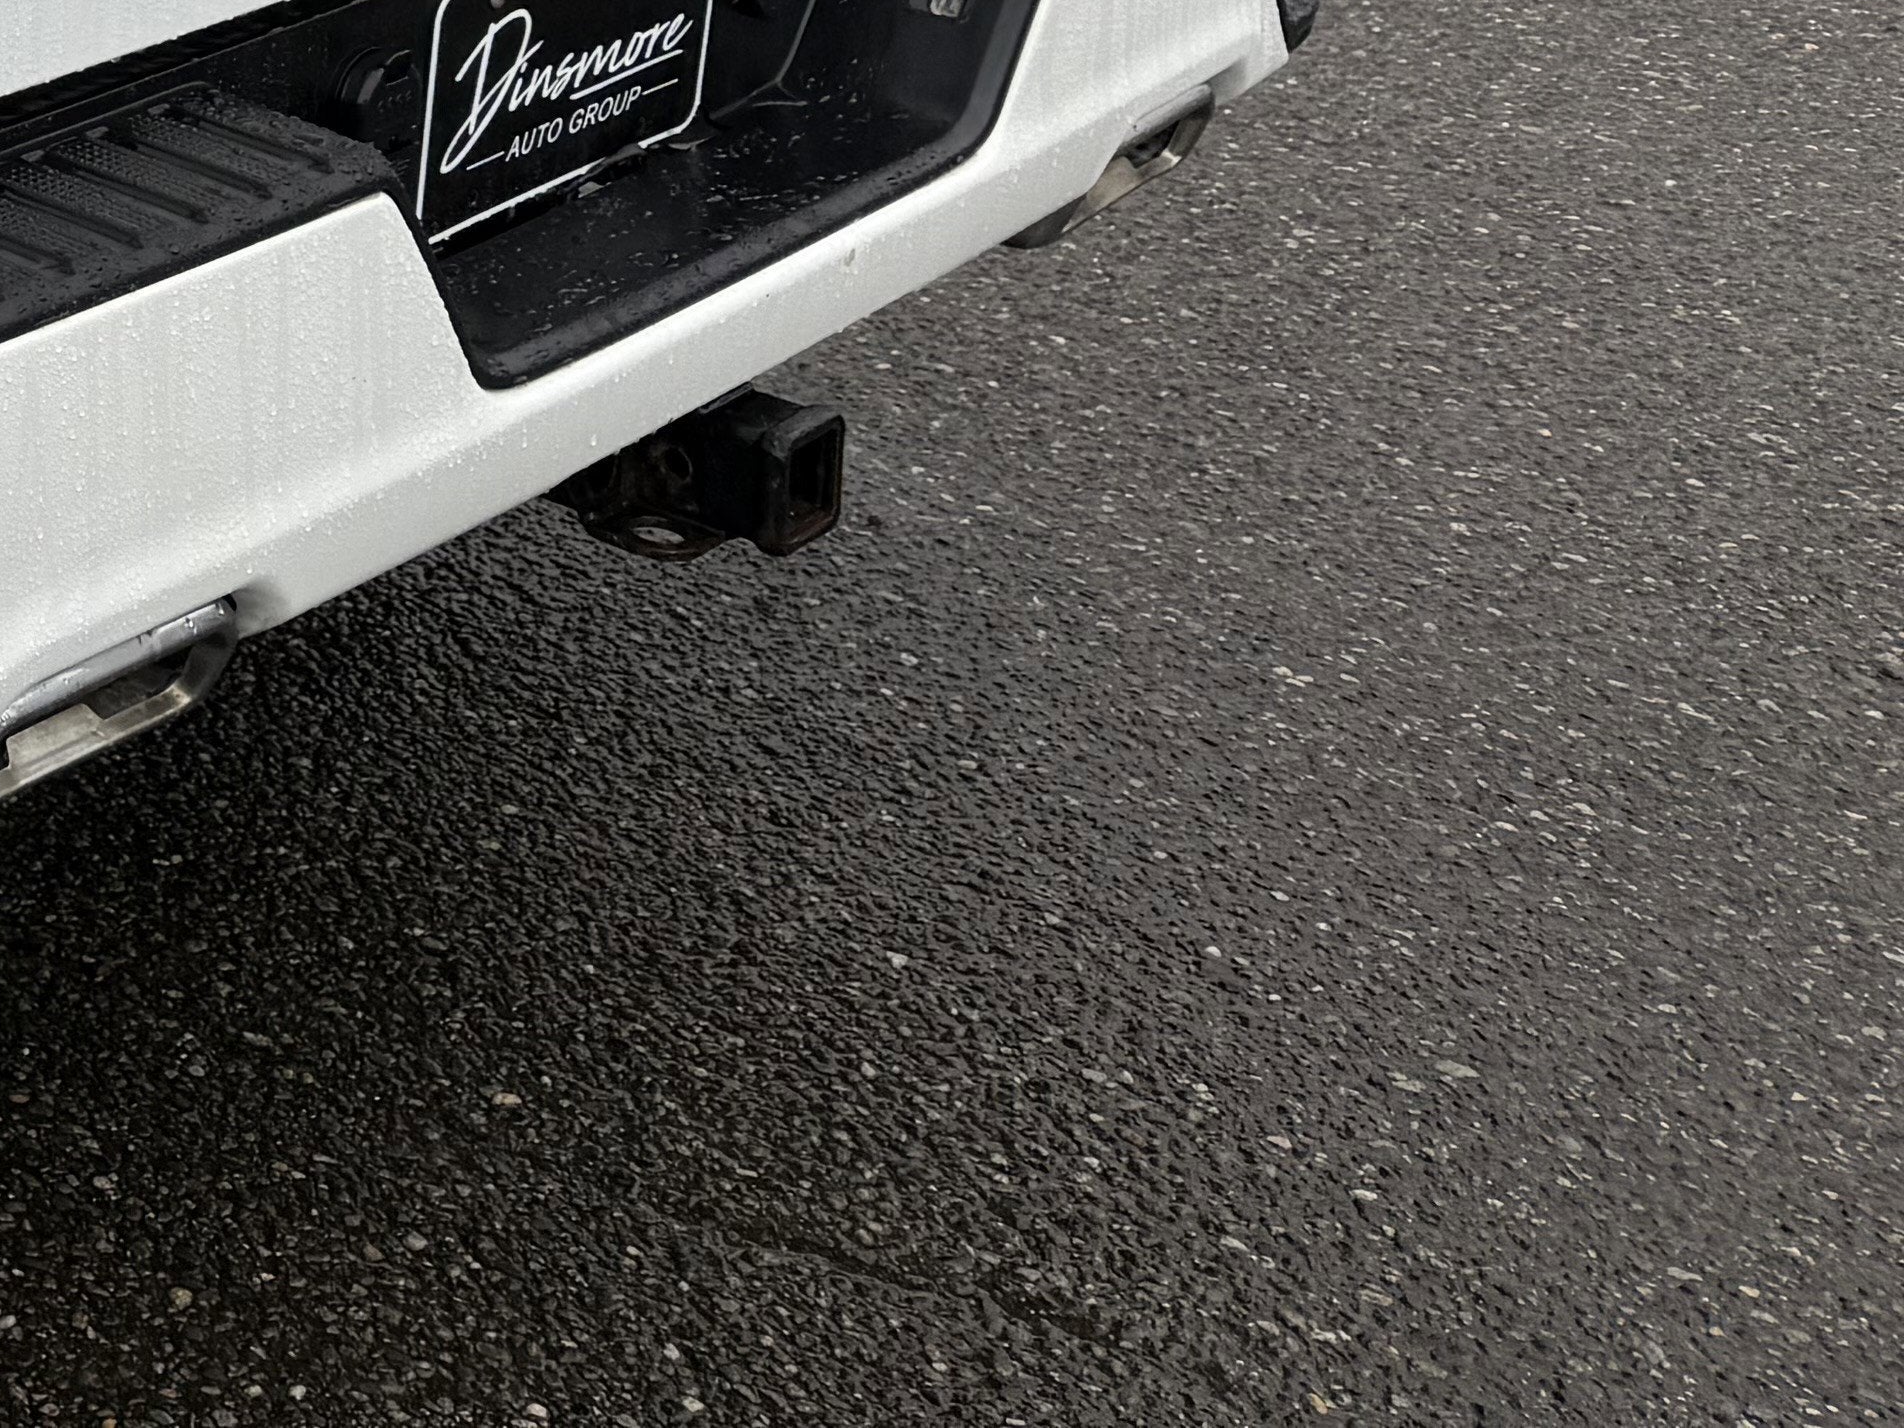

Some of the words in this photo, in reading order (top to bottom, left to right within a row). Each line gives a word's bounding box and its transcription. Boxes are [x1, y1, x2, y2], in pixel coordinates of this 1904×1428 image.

[439, 8, 694, 174] Dinsmore
[505, 117, 564, 162] AUTO
[568, 85, 642, 135] GROUP
